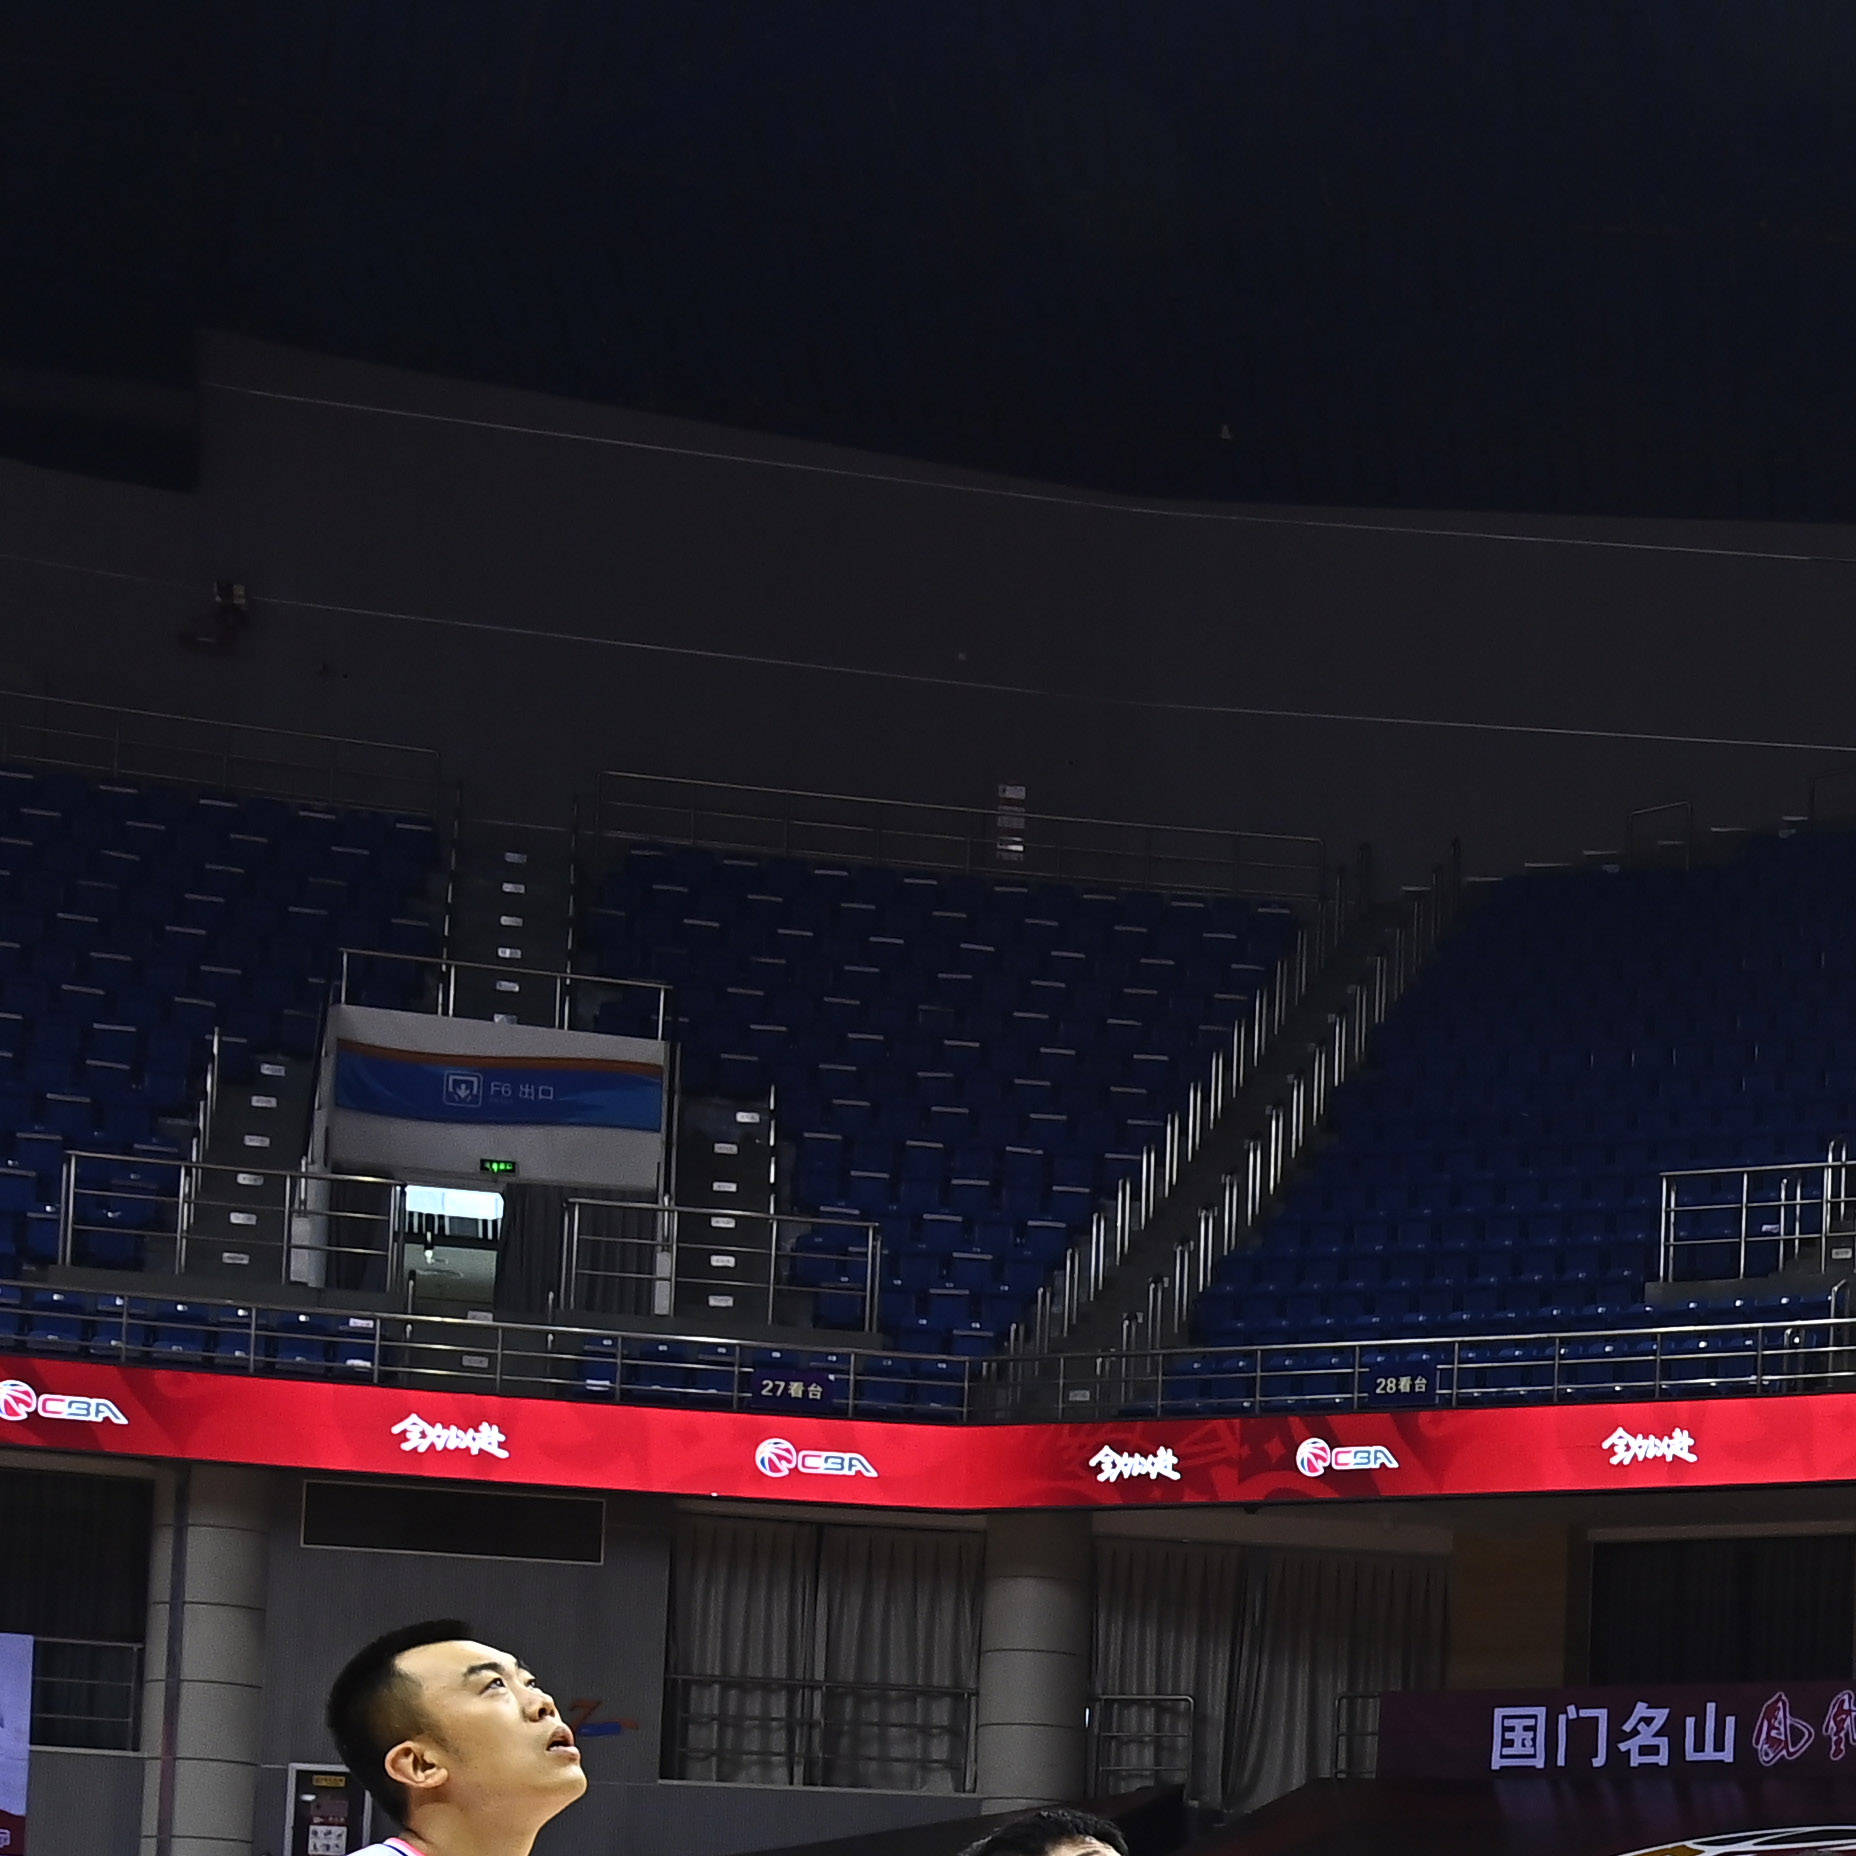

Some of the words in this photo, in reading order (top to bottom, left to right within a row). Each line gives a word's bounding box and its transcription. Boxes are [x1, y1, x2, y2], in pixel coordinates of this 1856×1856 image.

[490, 1082, 511, 1097] F6
[519, 1084, 553, 1100] 出口
[761, 1380, 823, 1401] 27看台
[1375, 1375, 1428, 1395] 28看台
[38, 1394, 128, 1424] CBA
[795, 1450, 878, 1477] CBA
[1329, 1446, 1399, 1470] CBA
